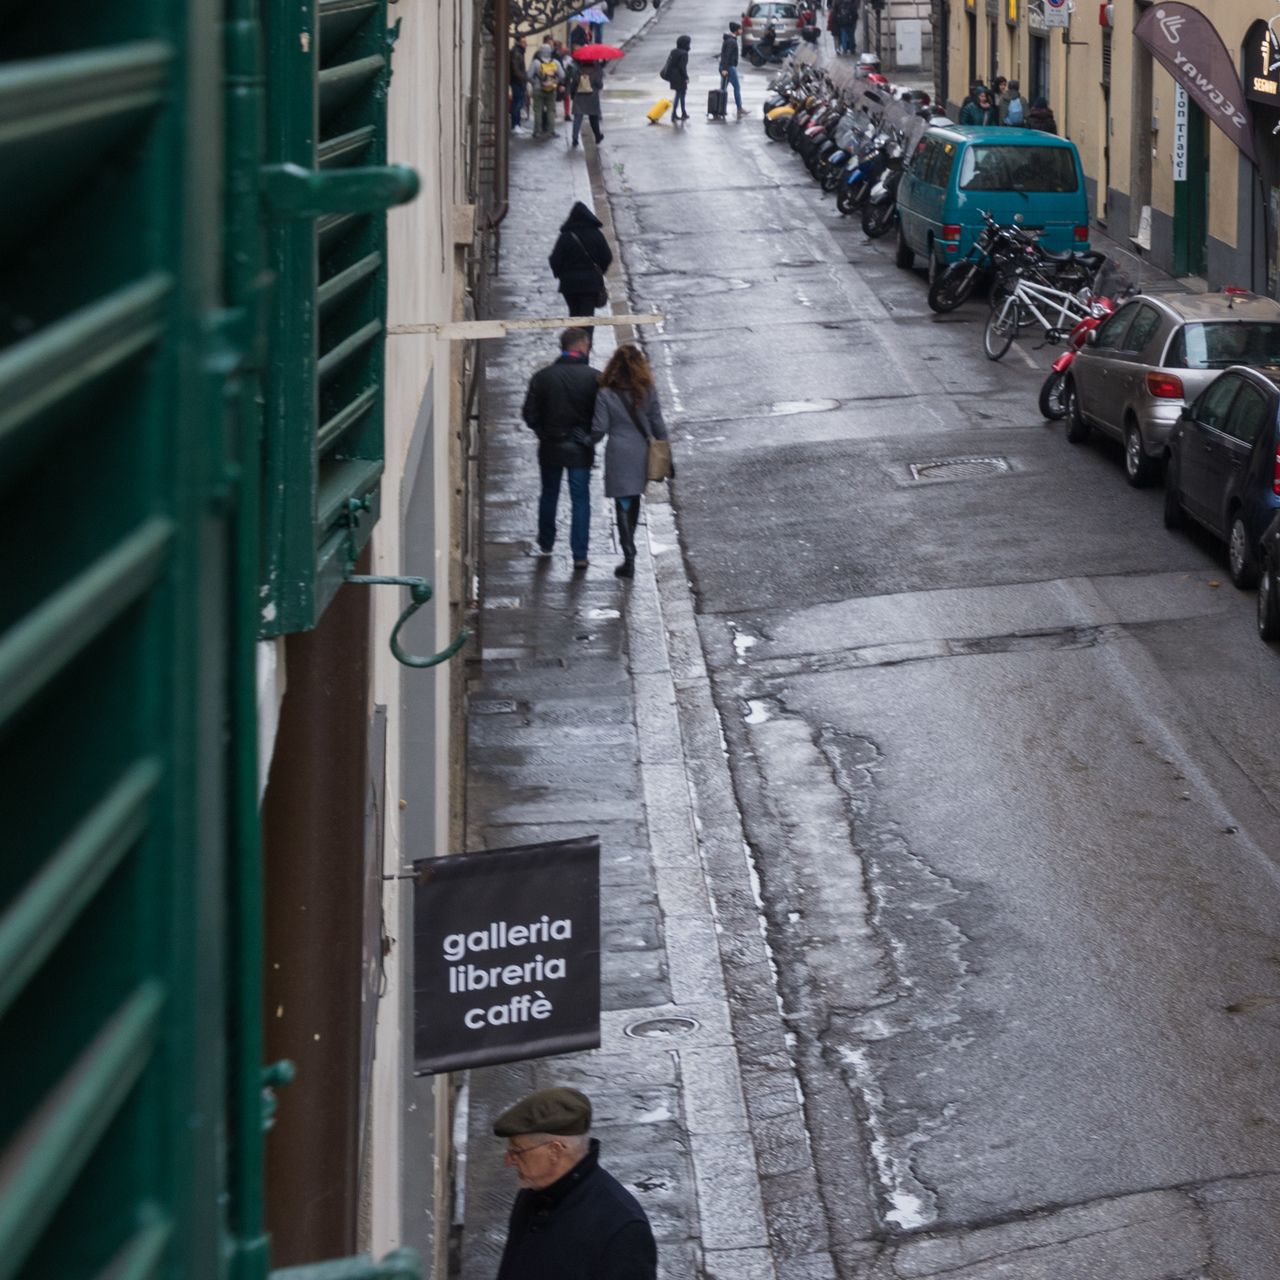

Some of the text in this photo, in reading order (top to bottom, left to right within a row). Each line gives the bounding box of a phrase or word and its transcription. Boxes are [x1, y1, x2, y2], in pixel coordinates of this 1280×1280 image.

[1176, 123, 1187, 179] Travel
[443, 915, 572, 961] galleria
[449, 954, 566, 993] libreria
[464, 990, 553, 1030] caffè
